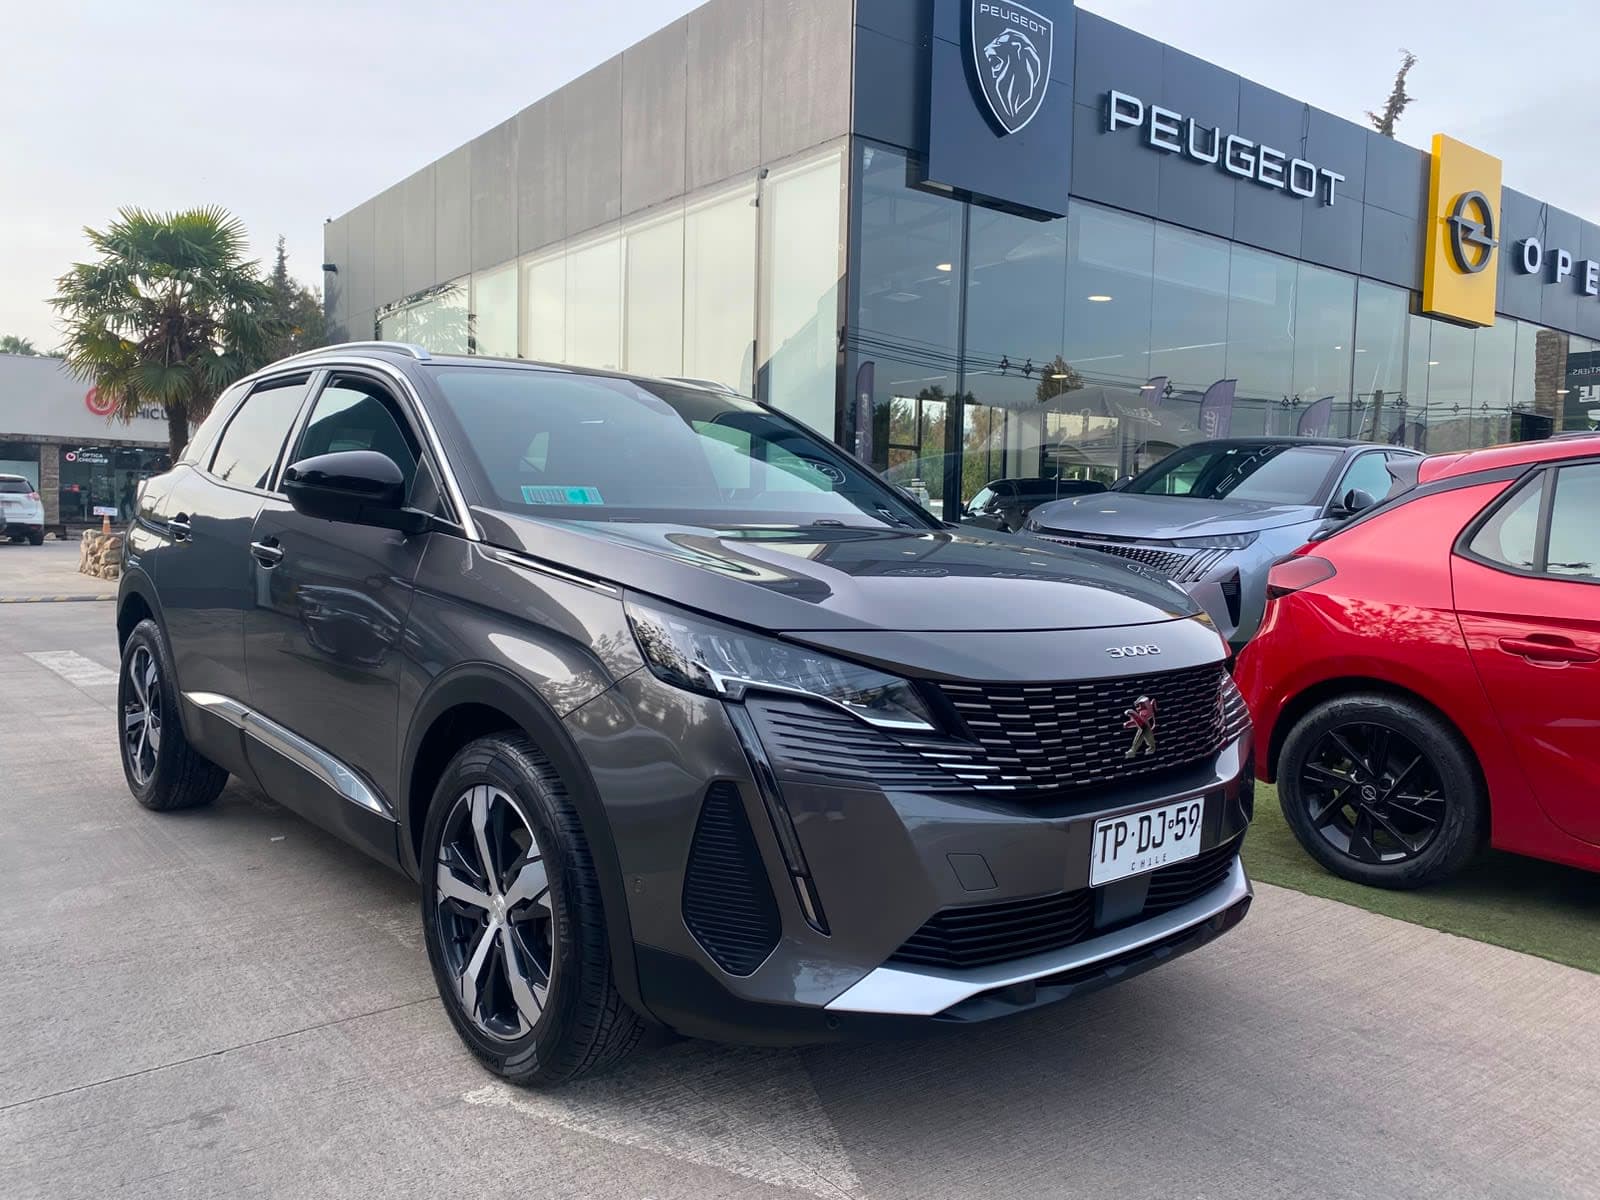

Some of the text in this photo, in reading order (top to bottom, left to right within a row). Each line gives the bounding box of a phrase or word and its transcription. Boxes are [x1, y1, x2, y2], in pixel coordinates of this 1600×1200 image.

[980, 4, 1047, 35] PEUGEOT
[1107, 89, 1345, 206] PEUGEOT
[1105, 645, 1161, 658] 3008
[1130, 853, 1167, 871] CHILE
